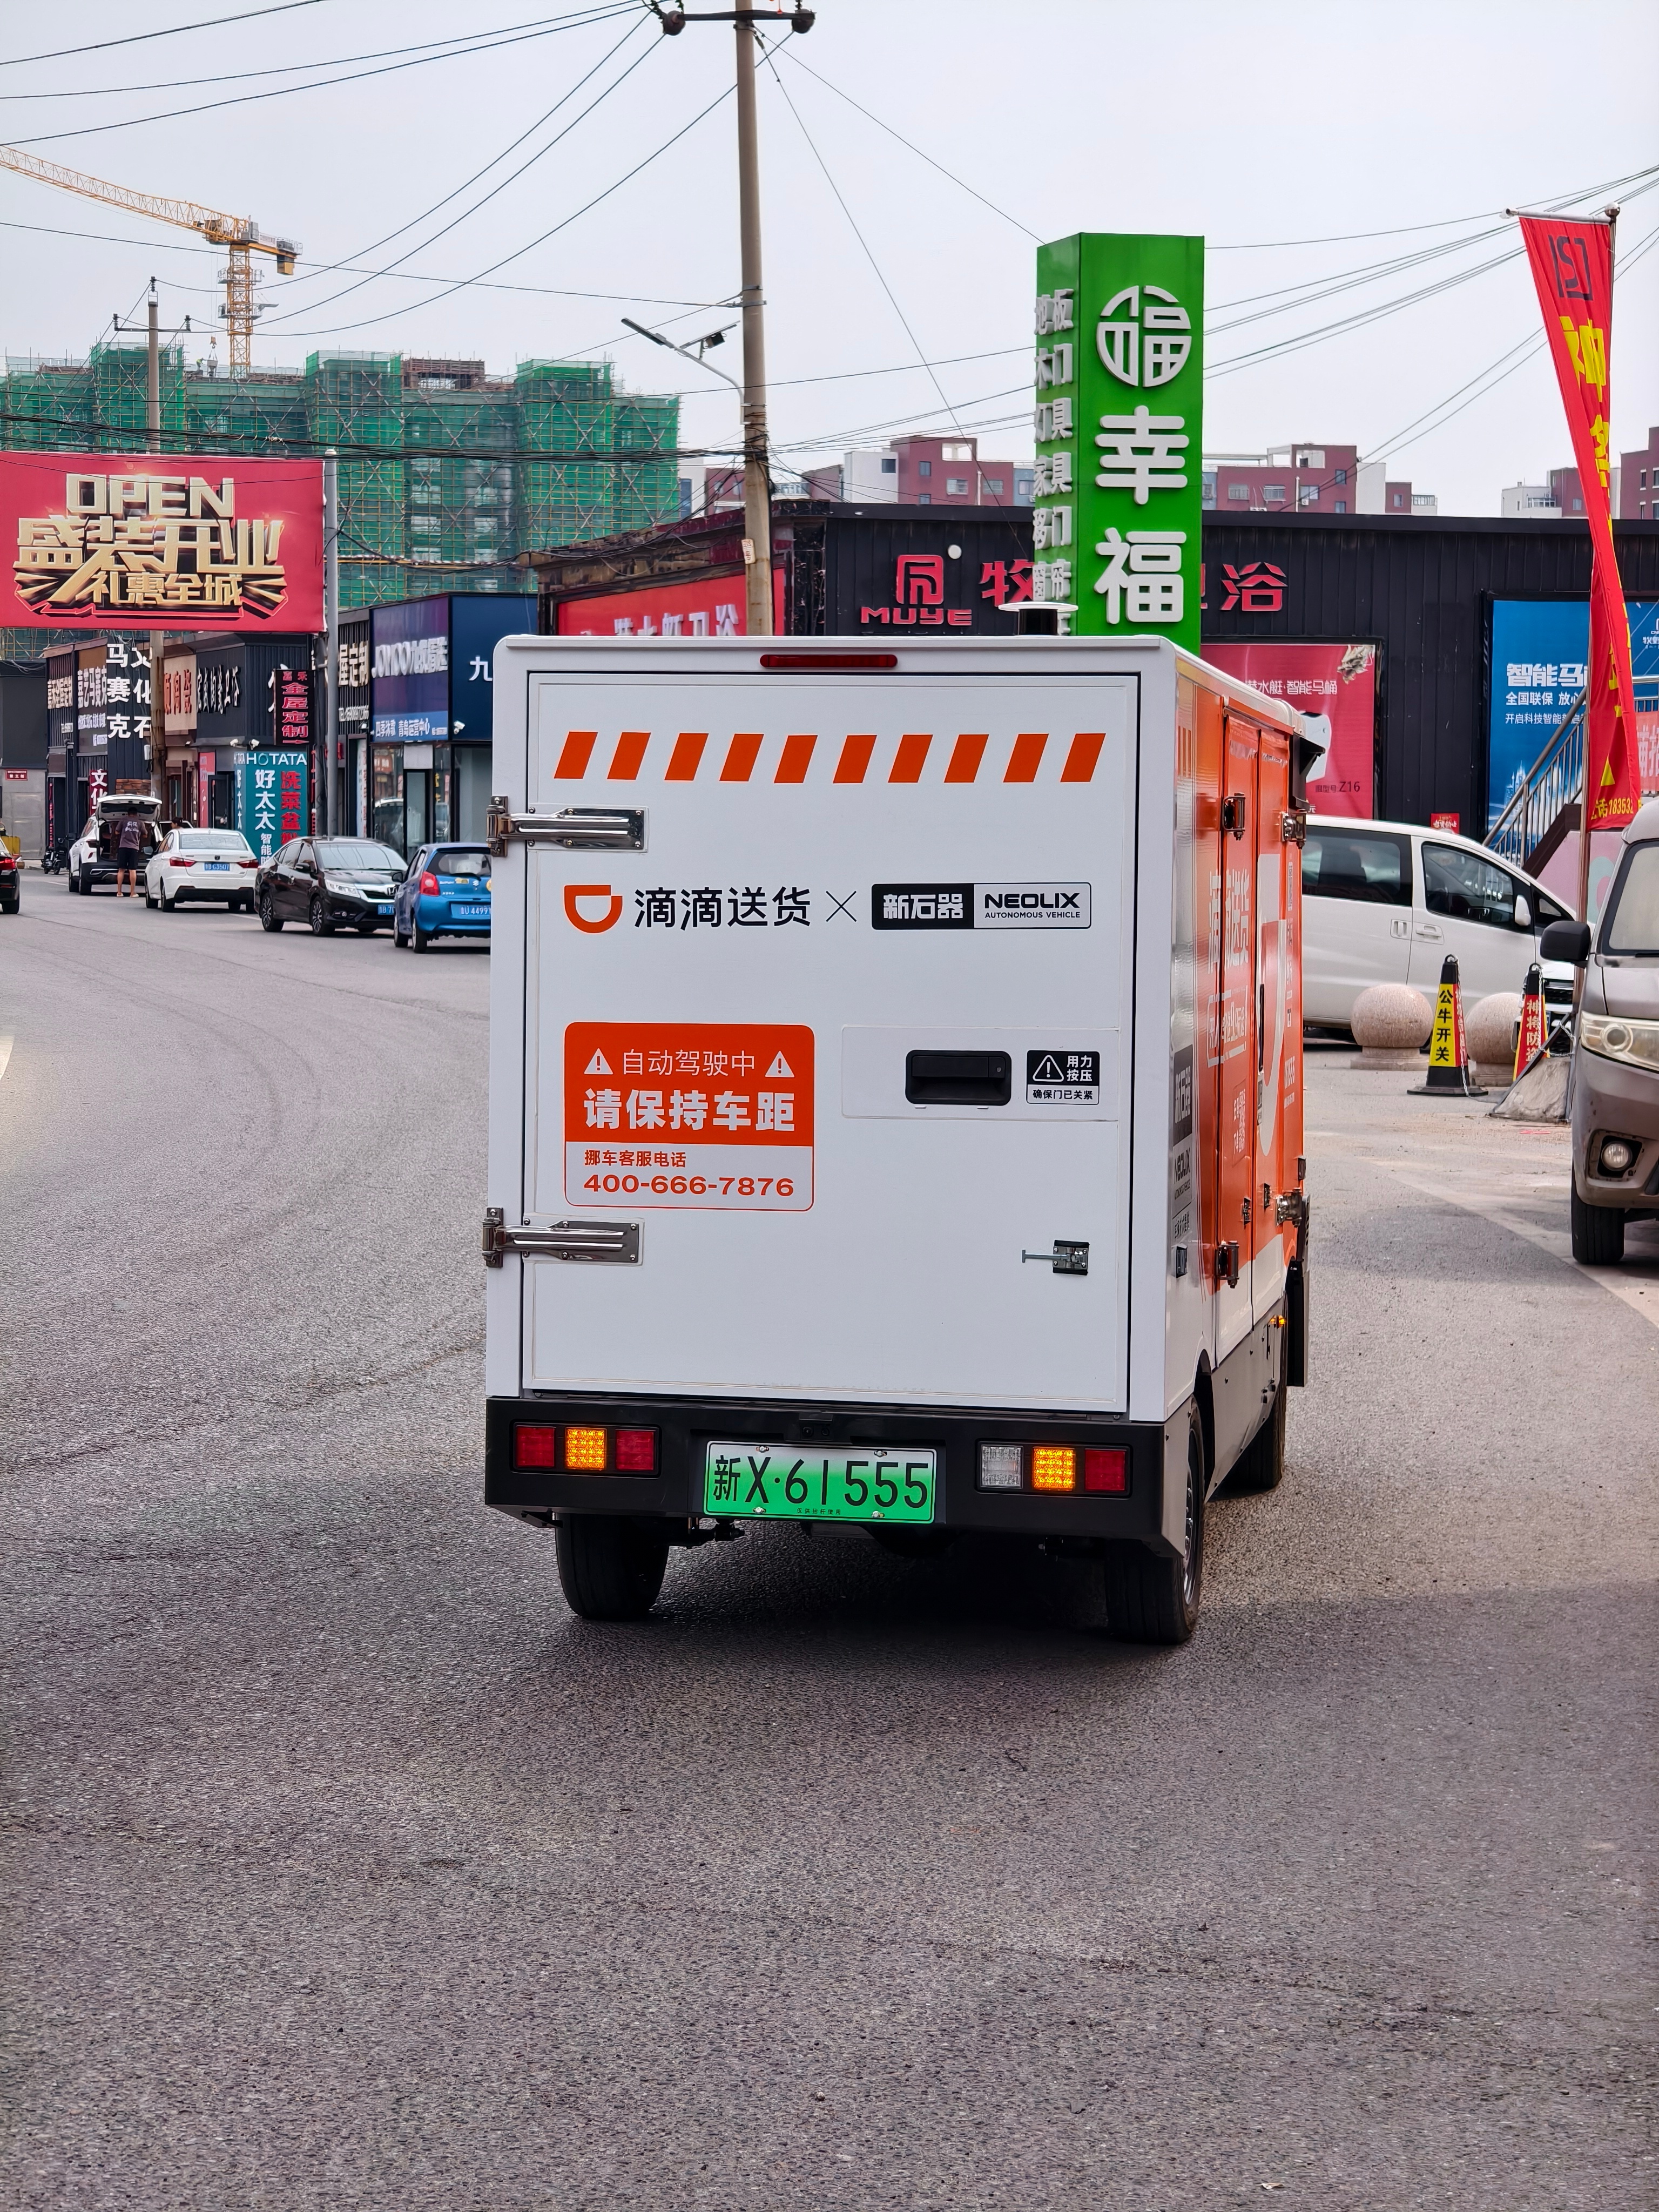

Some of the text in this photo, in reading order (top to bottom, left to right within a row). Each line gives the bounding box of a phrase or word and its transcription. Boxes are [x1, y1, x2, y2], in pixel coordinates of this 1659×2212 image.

[1034, 343, 1073, 389] 木门
[1033, 452, 1073, 497] 家具
[66, 473, 234, 517] OPEN
[1094, 405, 1190, 624] 幸福
[13, 514, 285, 602] 盛装开业
[76, 570, 243, 606] 礼惠全城
[861, 606, 972, 626] MUYE
[106, 643, 131, 739] 马赛克
[1507, 663, 1588, 686] 智能马
[281, 682, 309, 738] 全屋定制
[1506, 691, 1553, 706] 全国联保
[246, 753, 307, 766] HOTATA
[91, 768, 107, 810] 文化
[255, 769, 275, 831] 好太太
[1339, 781, 1361, 793] Z16
[634, 887, 811, 930] 滴滴送货
[883, 893, 964, 920] 新石器
[984, 893, 1080, 909] NEOLIX
[1435, 989, 1454, 1062] 公牛开关
[623, 1049, 756, 1077] 自动驾驶中
[1066, 1069, 1092, 1082] 按压
[1067, 1055, 1092, 1068] 用力
[584, 1088, 795, 1131] 请保持车距
[1033, 1089, 1093, 1100] 确保门已关紧
[1175, 1065, 1191, 1124] 新石器
[584, 1149, 686, 1168] 挪车客服电话
[1174, 1148, 1190, 1185] NEOLIX
[584, 1174, 795, 1197] 400-666-7876
[712, 1454, 929, 1508] 新X·61555
